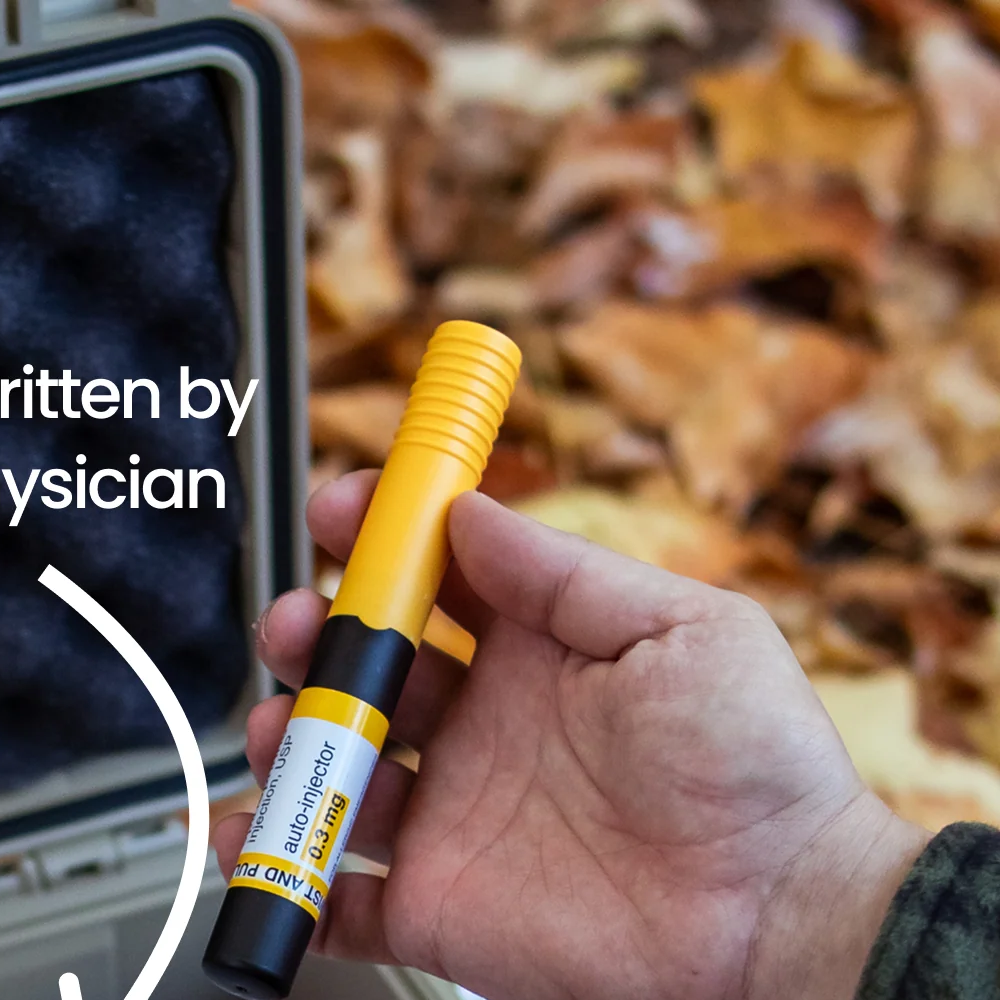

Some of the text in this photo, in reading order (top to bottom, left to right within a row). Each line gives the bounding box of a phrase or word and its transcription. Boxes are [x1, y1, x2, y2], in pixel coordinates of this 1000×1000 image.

[275, 735, 294, 770] USP
[284, 740, 337, 854] auto-injector
[308, 793, 347, 861] 0.3 mg
[235, 862, 324, 911] IST AND PUL
